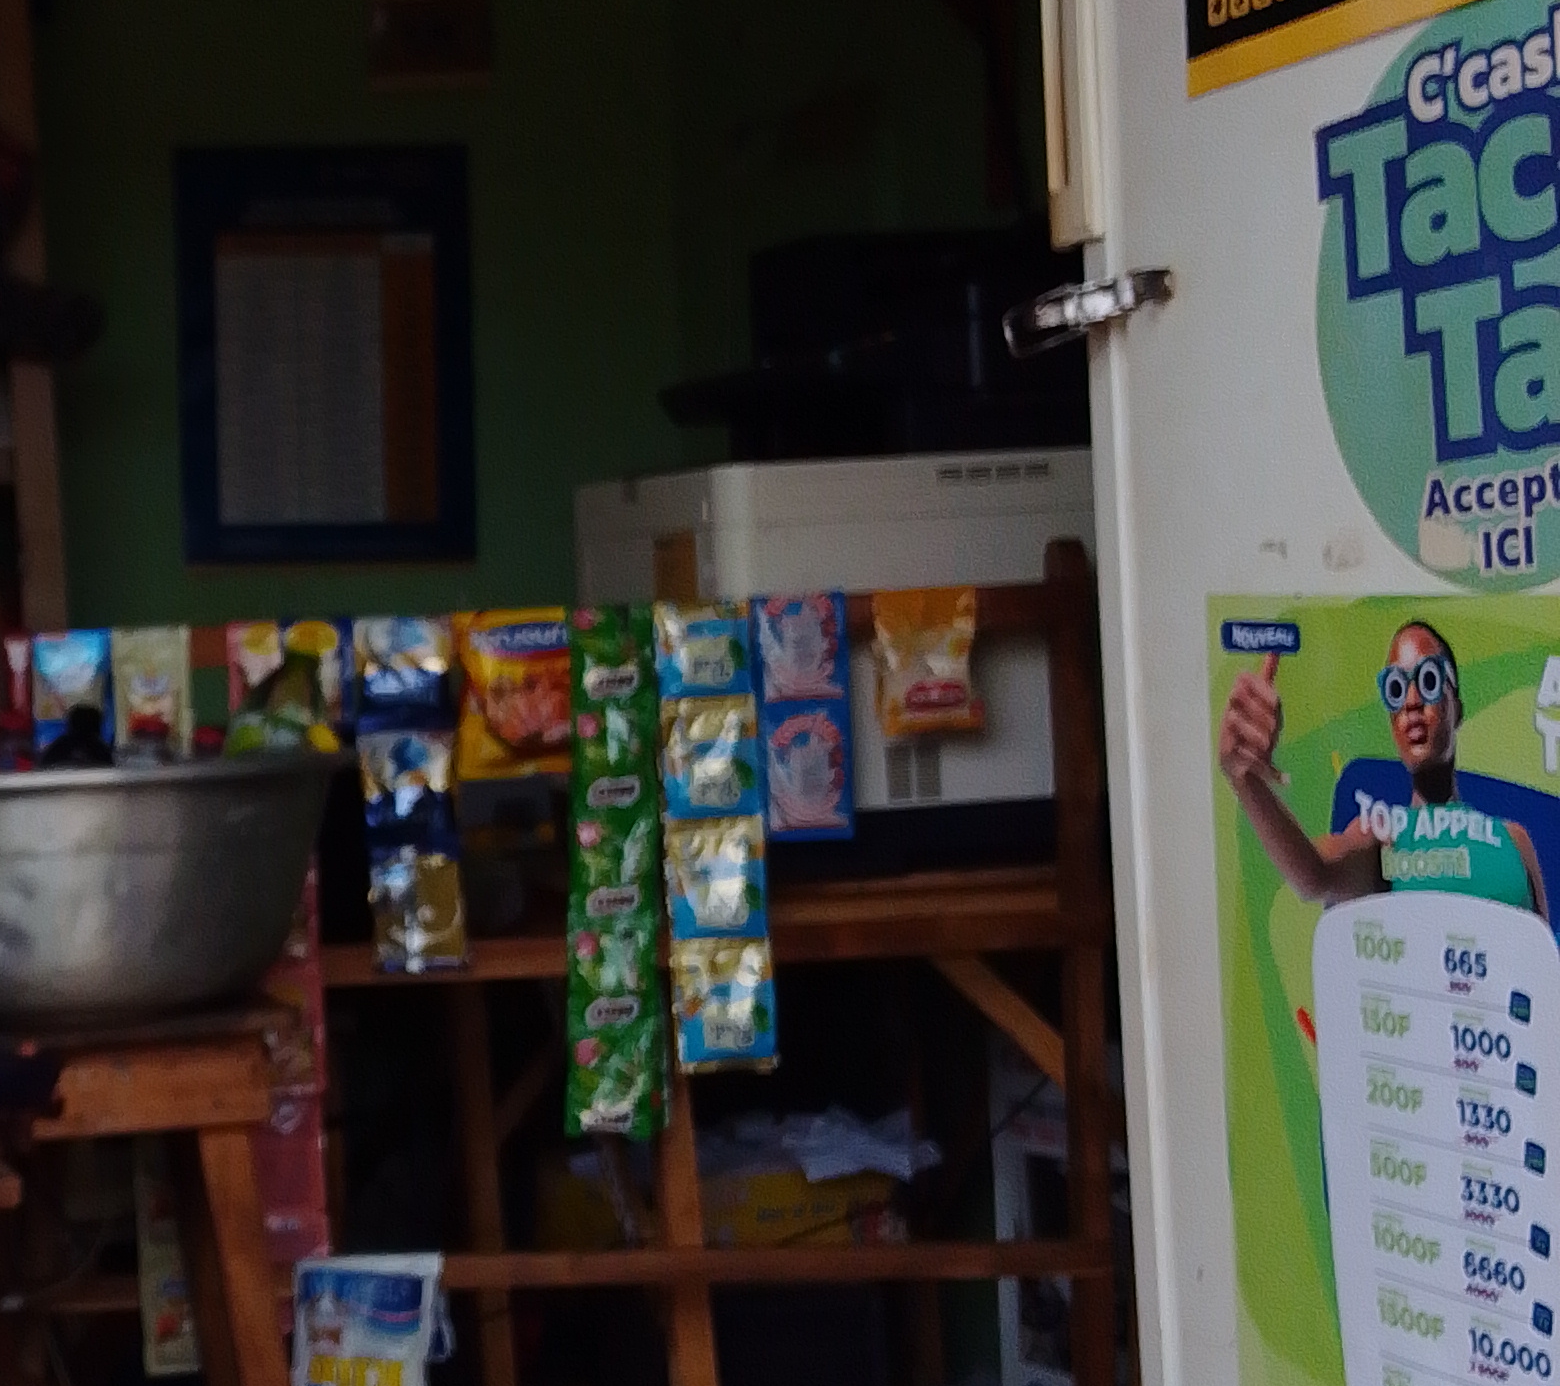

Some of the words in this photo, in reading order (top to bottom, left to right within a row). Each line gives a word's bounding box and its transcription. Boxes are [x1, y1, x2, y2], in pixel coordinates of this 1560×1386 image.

[1326, 113, 1559, 281] Tac
[1482, 525, 1535, 570] ICI
[1354, 788, 1408, 846] TOP
[1414, 804, 1502, 849] APPEL
[1444, 946, 1487, 979] 665
[1450, 1022, 1511, 1061] 1000
[1456, 1098, 1511, 1136] 1330
[1461, 1175, 1520, 1214] 3330
[1463, 1249, 1525, 1292] 6660
[1468, 1327, 1551, 1377] 10.000
